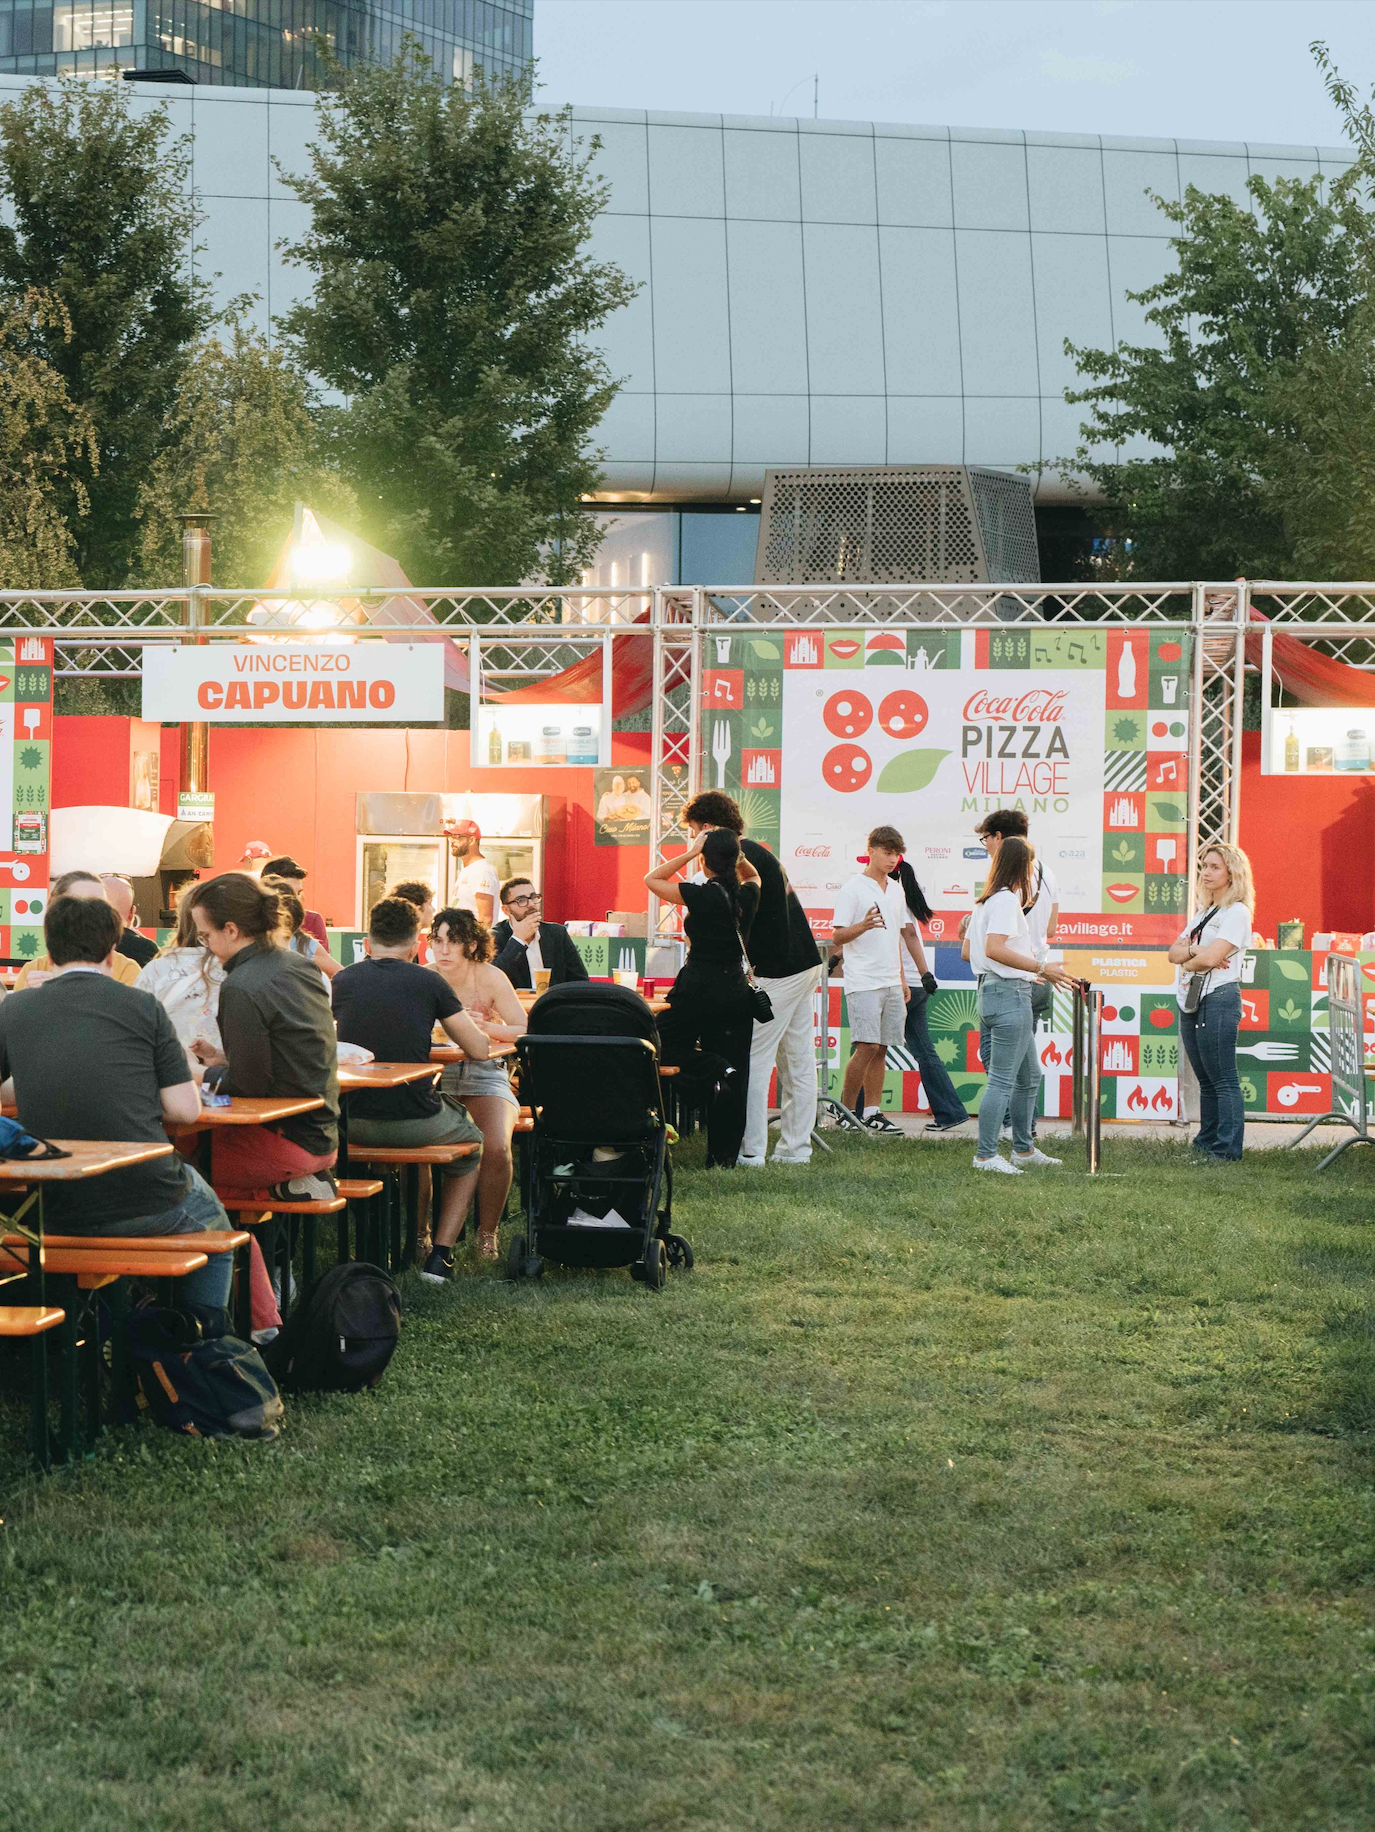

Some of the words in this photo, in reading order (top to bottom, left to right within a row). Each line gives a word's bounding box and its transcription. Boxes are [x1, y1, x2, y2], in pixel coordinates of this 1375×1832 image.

[233, 653, 351, 673] VINCENZO
[196, 679, 396, 710] CAPUANO
[961, 725, 1070, 759] PIZZA
[961, 761, 1070, 795] VILLAGE
[960, 796, 1070, 813] MILANO
[1055, 921, 1134, 937] zavillage.it
[1091, 957, 1148, 968] PLASTICA
[1099, 968, 1139, 978] PLASTIC
